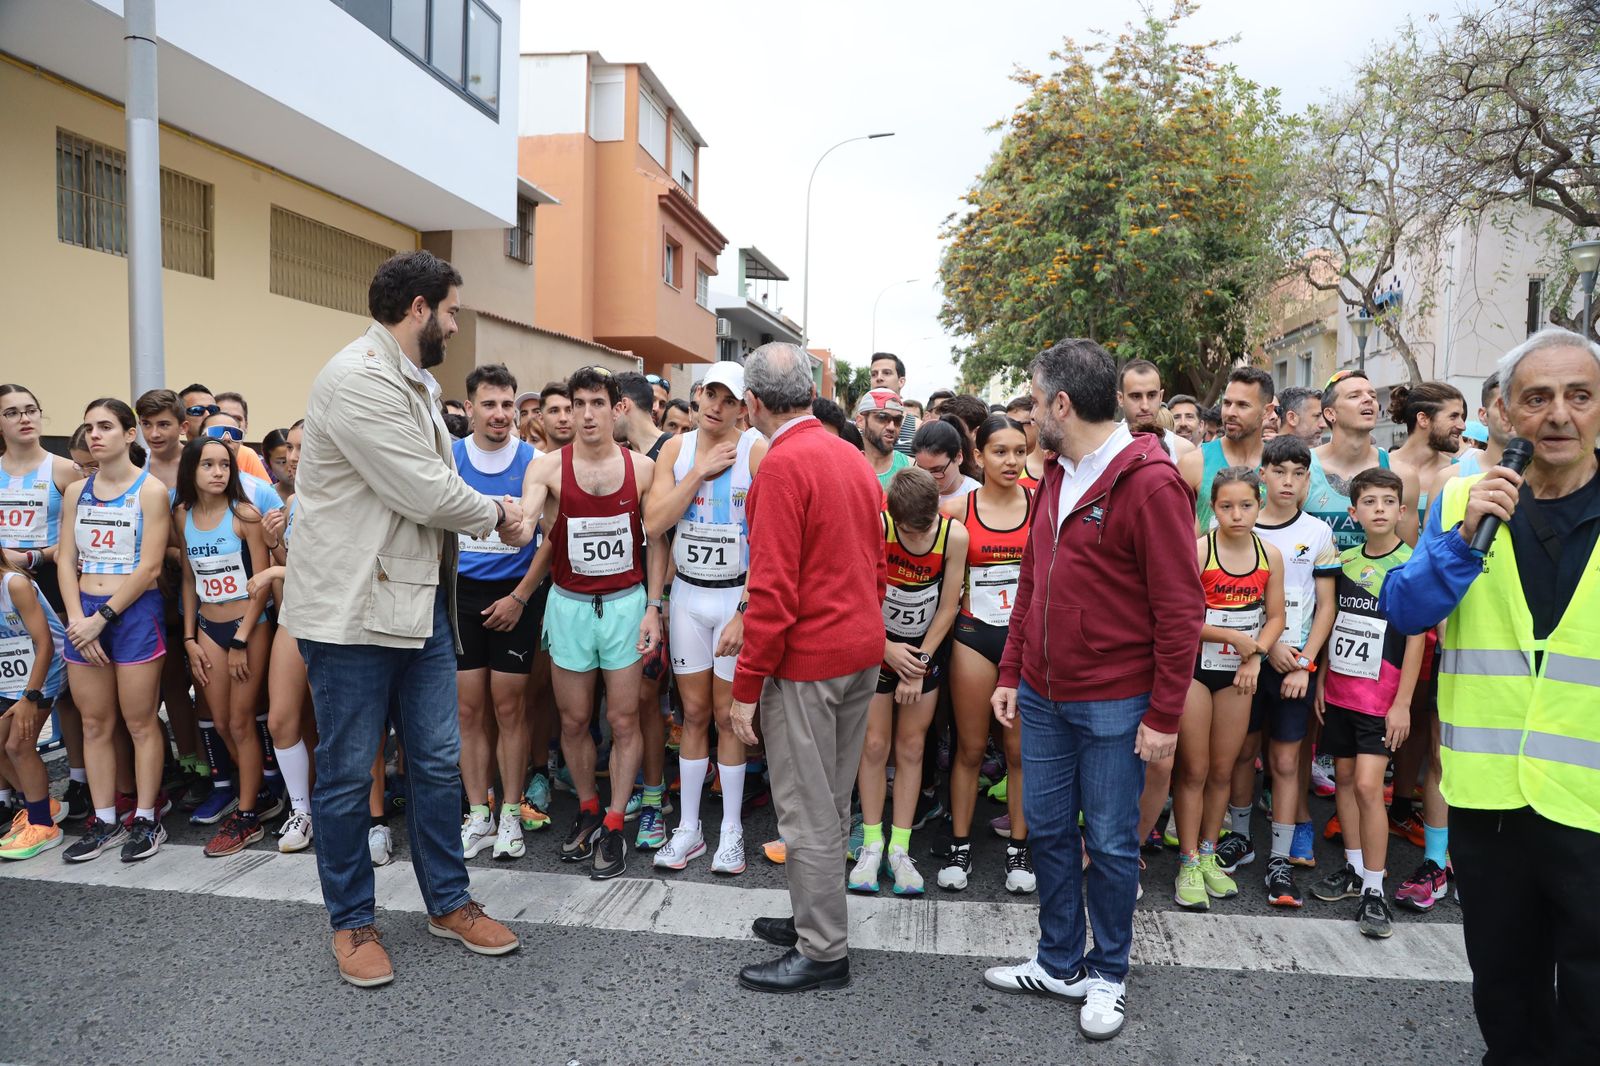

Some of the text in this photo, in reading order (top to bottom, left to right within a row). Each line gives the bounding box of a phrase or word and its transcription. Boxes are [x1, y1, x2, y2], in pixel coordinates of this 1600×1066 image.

[90, 528, 115, 549] 24
[583, 539, 625, 562] 504
[687, 544, 727, 566] 571
[203, 575, 237, 597] 298
[1214, 585, 1258, 596] Málaga
[1225, 593, 1257, 602] Bahía
[888, 606, 927, 626] 751
[1335, 636, 1369, 662] 674
[0, 659, 28, 678] 80
